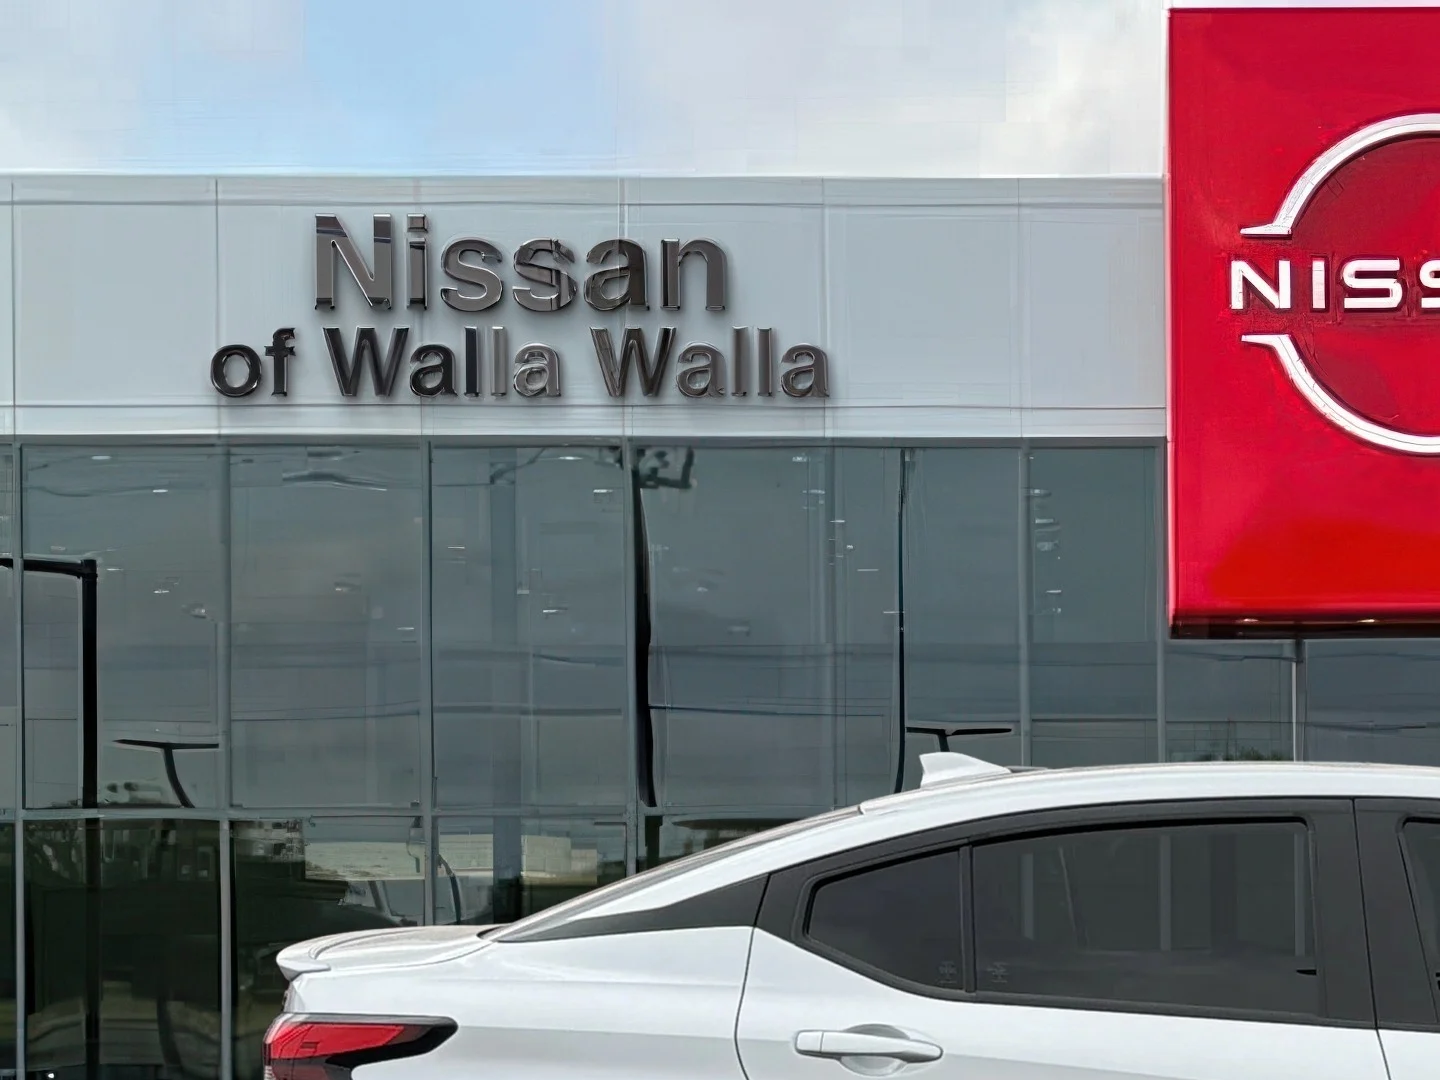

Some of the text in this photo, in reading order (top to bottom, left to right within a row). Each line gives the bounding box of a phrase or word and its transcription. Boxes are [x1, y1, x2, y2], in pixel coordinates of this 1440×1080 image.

[313, 212, 728, 311] Nissan
[209, 325, 830, 398] of Walla Walla
